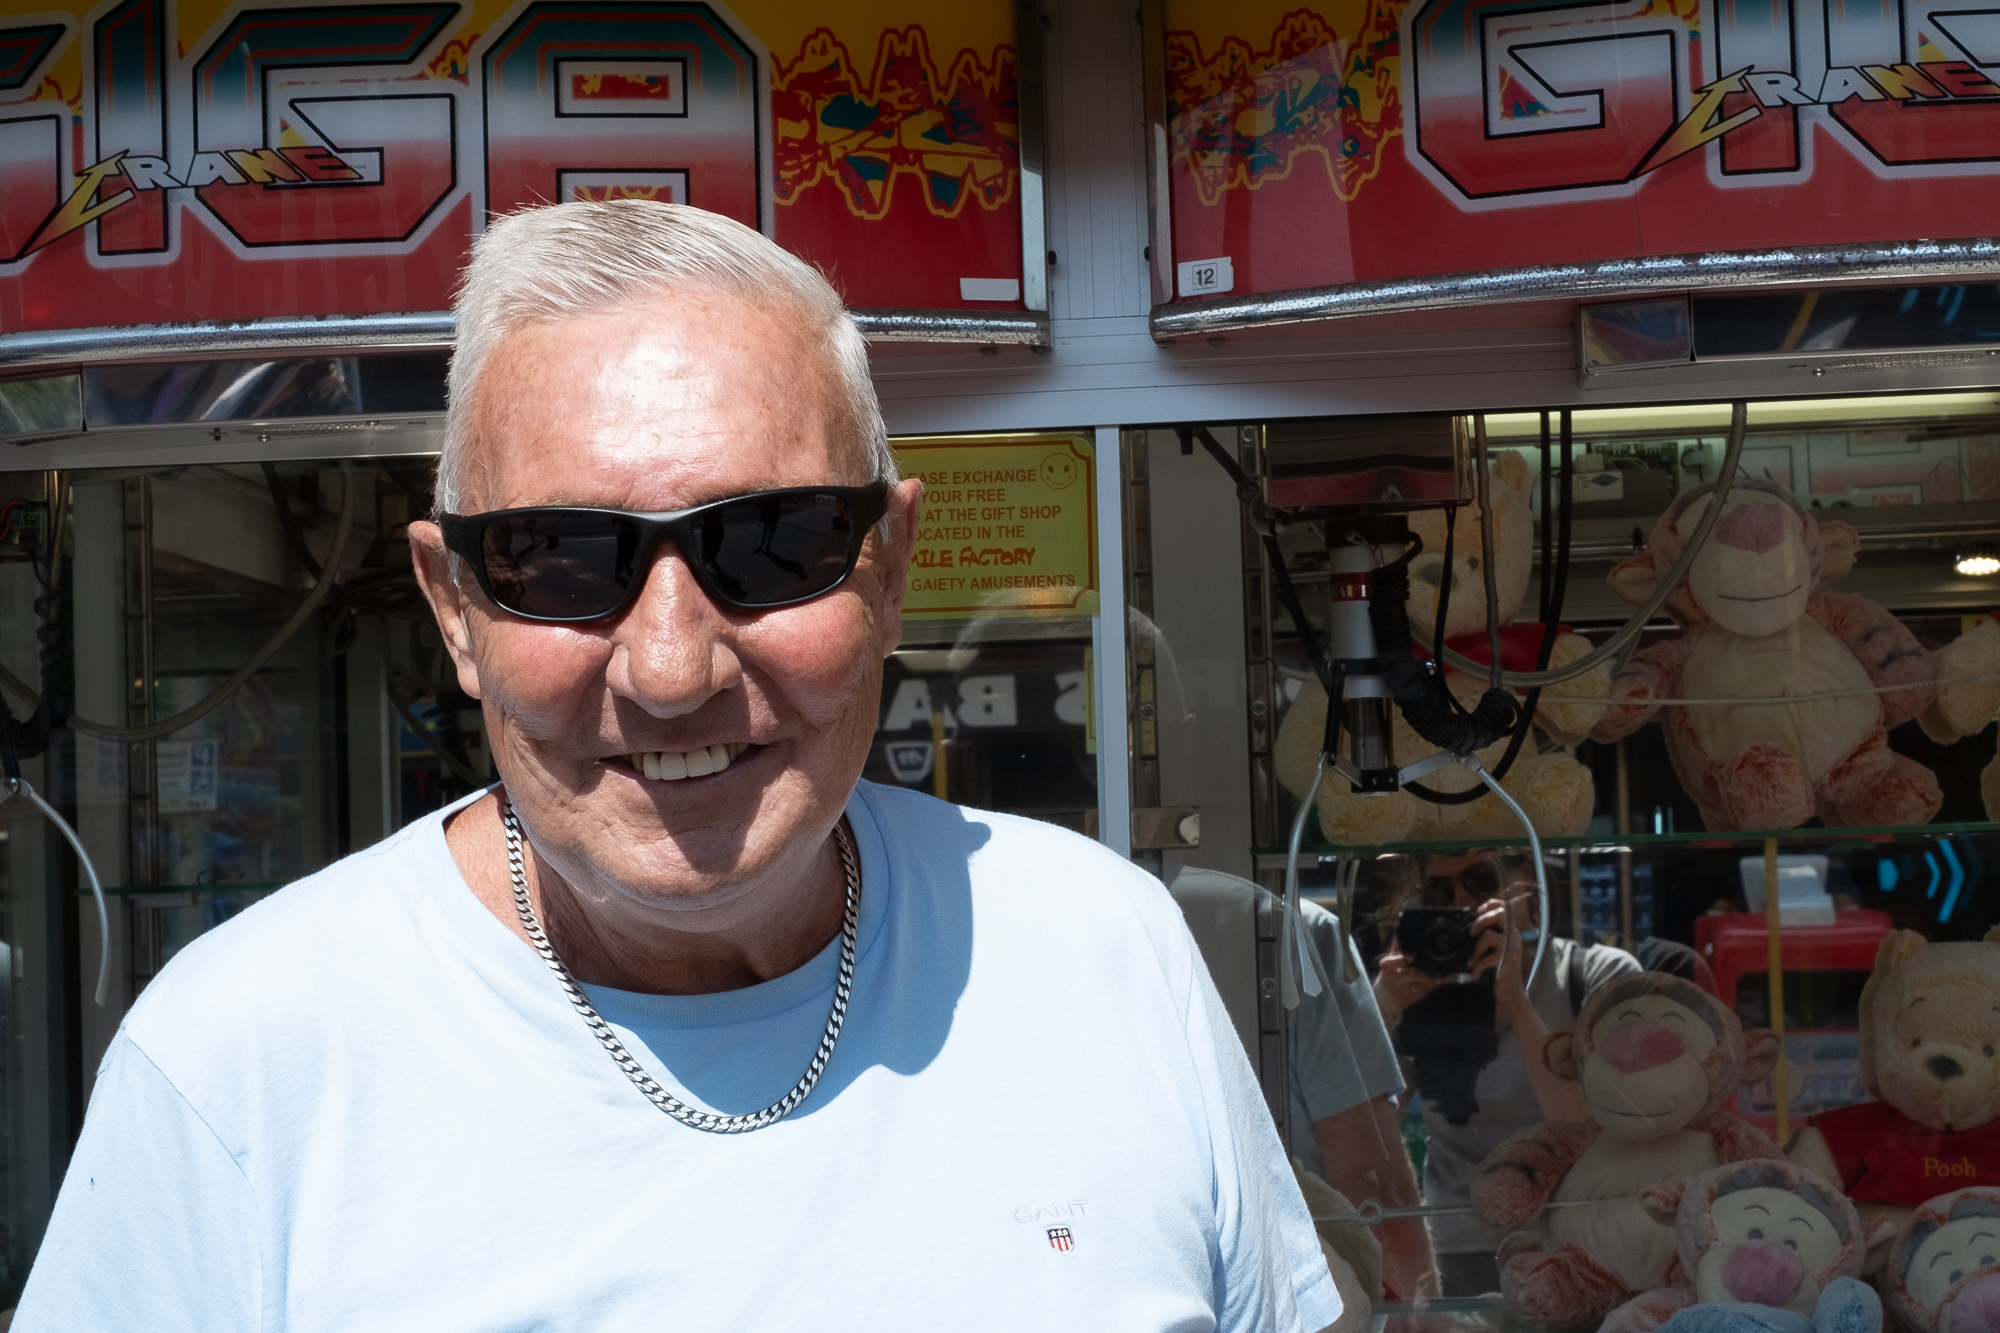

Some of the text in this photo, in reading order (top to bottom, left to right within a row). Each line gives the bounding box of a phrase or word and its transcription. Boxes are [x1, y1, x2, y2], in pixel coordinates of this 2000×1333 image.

[0, 0, 762, 262] IGA
[1195, 268, 1215, 286] 12
[953, 468, 1037, 484] EXCHANGE
[967, 488, 1006, 502] FREE
[924, 509, 943, 523] AT
[947, 508, 977, 521] THE
[981, 506, 1015, 520] GIFT
[1019, 505, 1062, 519] SHOP
[977, 526, 991, 539] IN
[996, 525, 1026, 538] THE
[959, 546, 1036, 567] FACTORY
[911, 577, 966, 591] GAIETY
[970, 574, 1076, 590] AMUSEMENTS
[1921, 1156, 1977, 1178] Pooh
[1014, 1199, 1088, 1224] GANT
